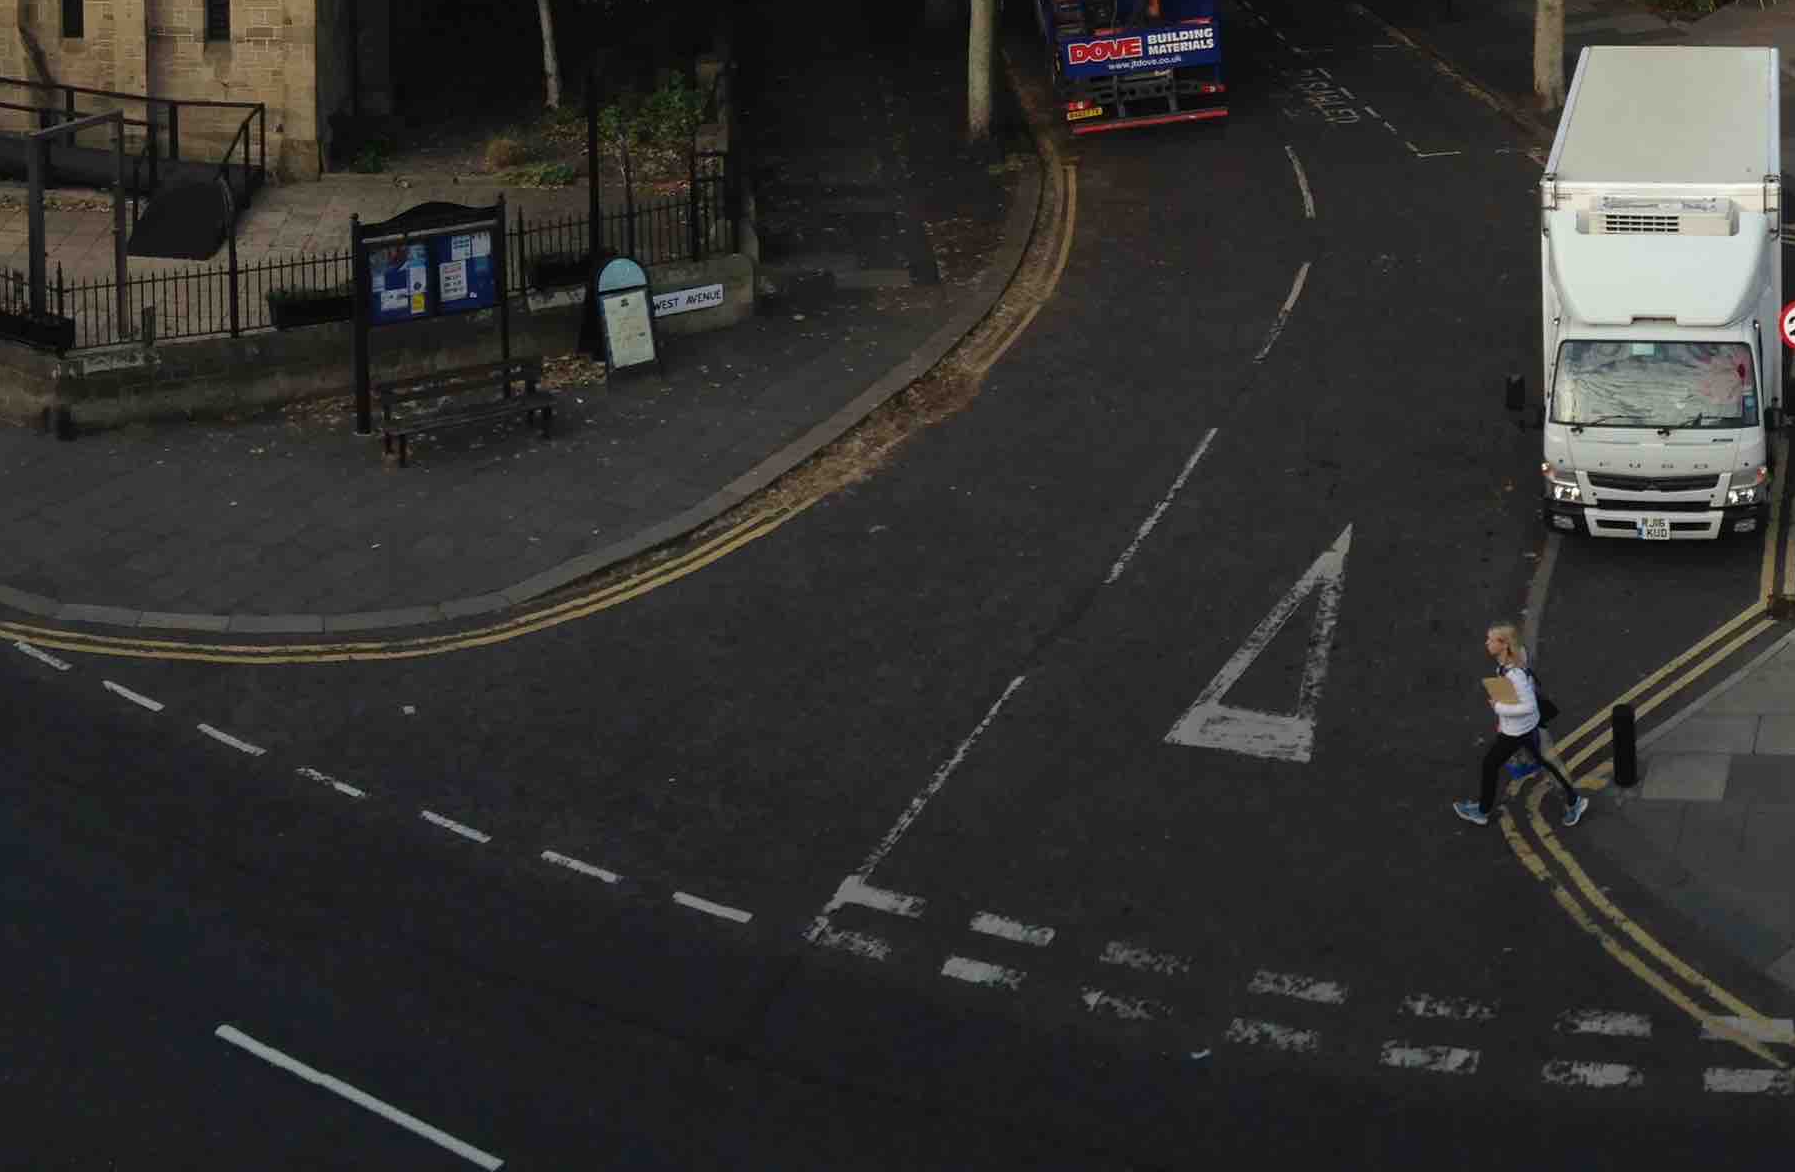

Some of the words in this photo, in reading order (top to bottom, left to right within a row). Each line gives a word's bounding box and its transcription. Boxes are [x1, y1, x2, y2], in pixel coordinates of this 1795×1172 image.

[1067, 36, 1144, 65] DOVE
[1147, 27, 1214, 45] BUILDING
[1148, 38, 1214, 56] MATERIALS
[653, 297, 679, 311] WEST
[685, 289, 722, 305] AVENUE
